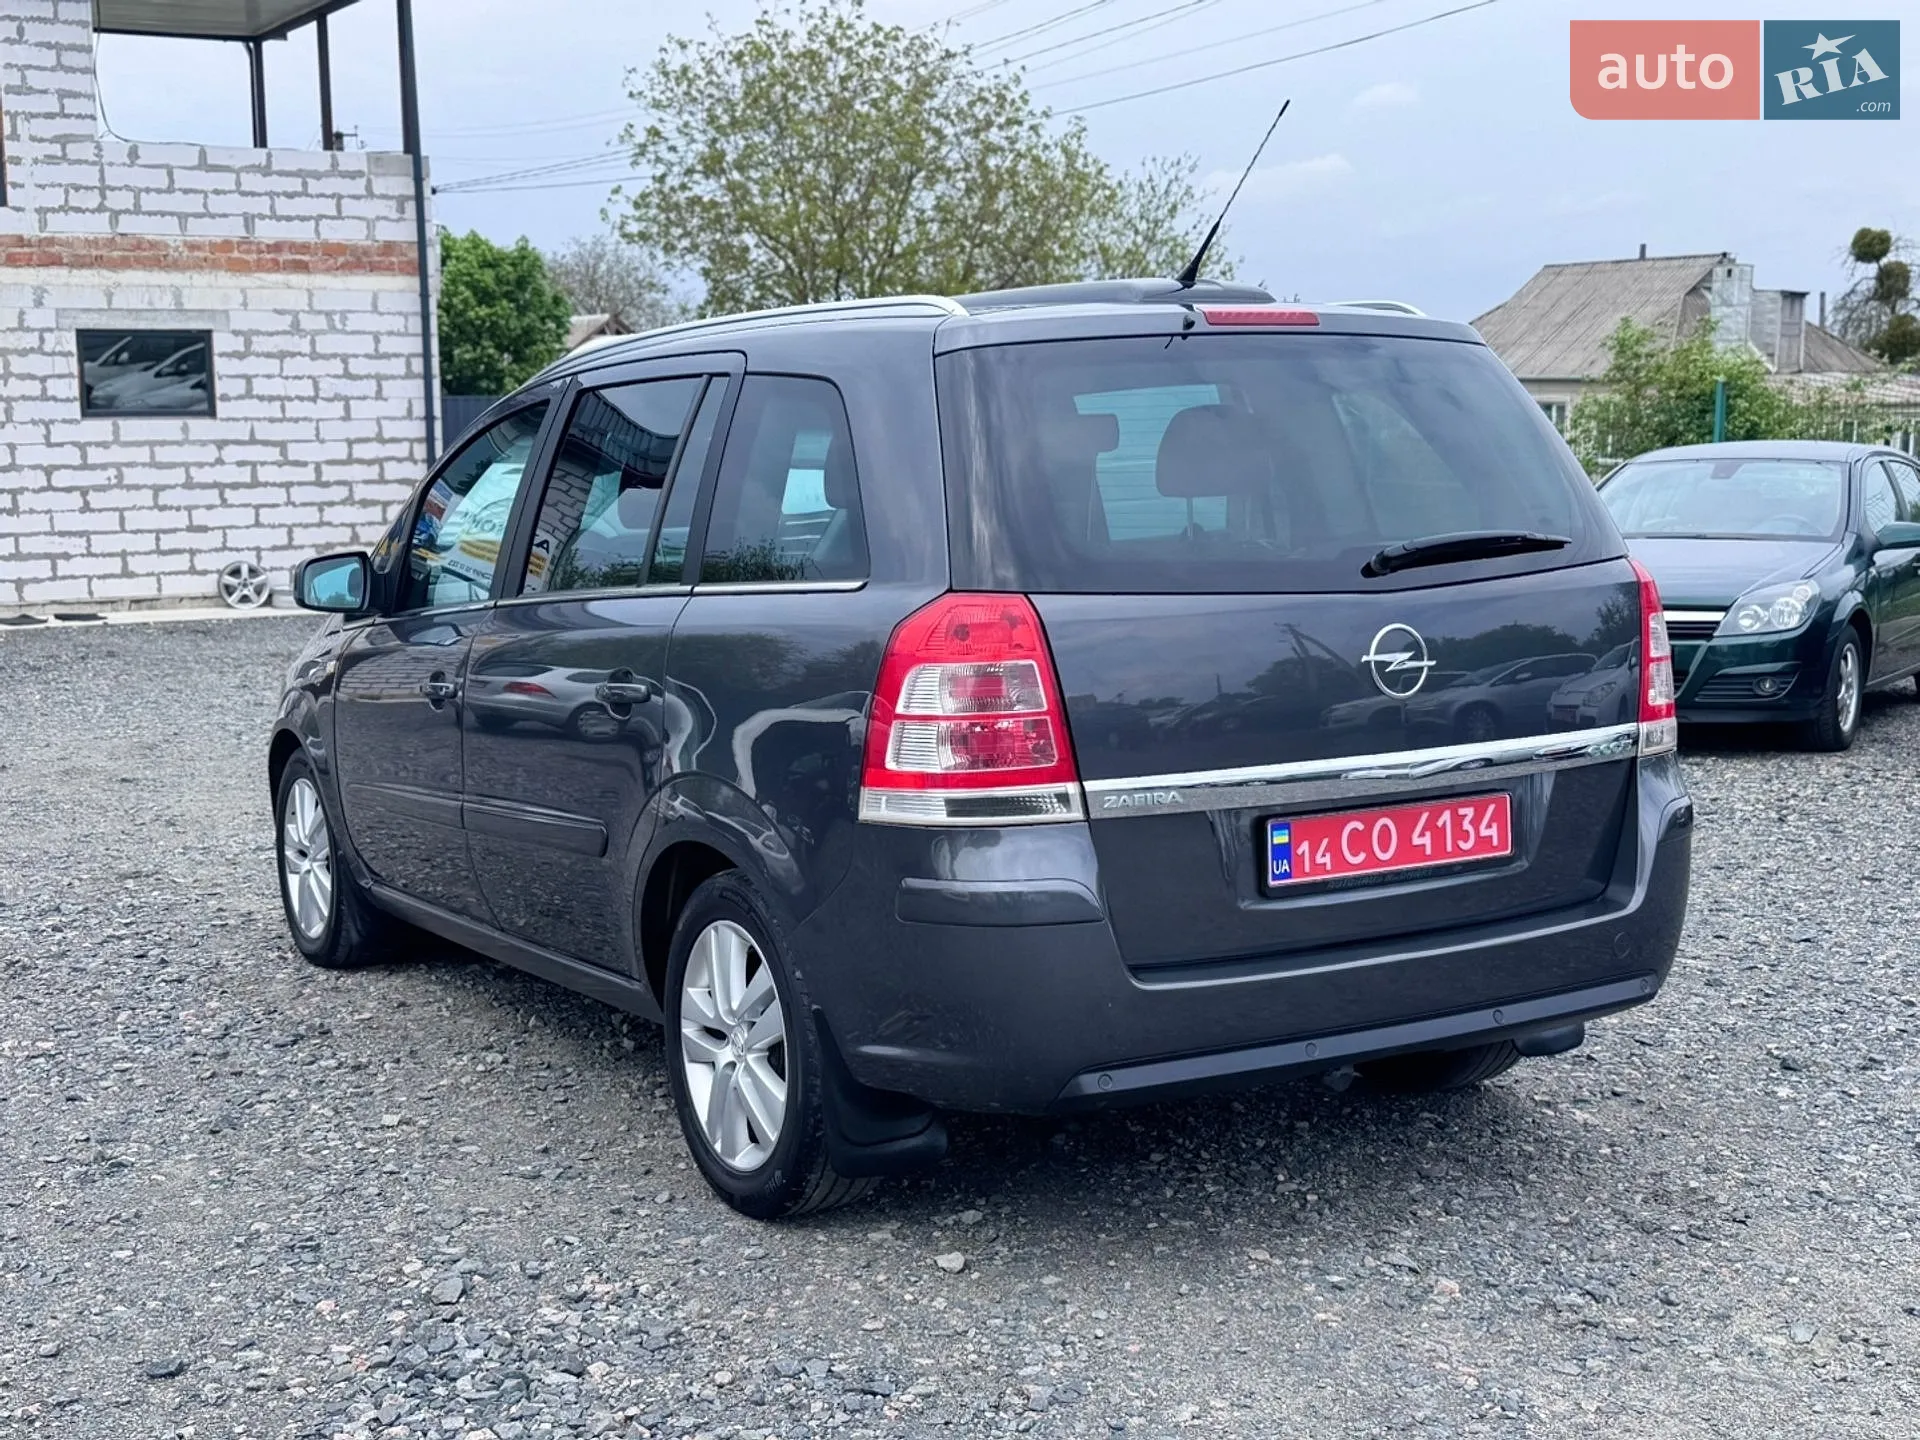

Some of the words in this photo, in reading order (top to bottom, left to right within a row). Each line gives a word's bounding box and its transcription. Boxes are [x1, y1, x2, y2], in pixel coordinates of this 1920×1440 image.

[1103, 791, 1183, 809] ZAFIRA
[1296, 838, 1332, 873] 14
[1341, 817, 1398, 865] CO
[1411, 803, 1499, 856] 4134
[1273, 858, 1290, 875] UA
